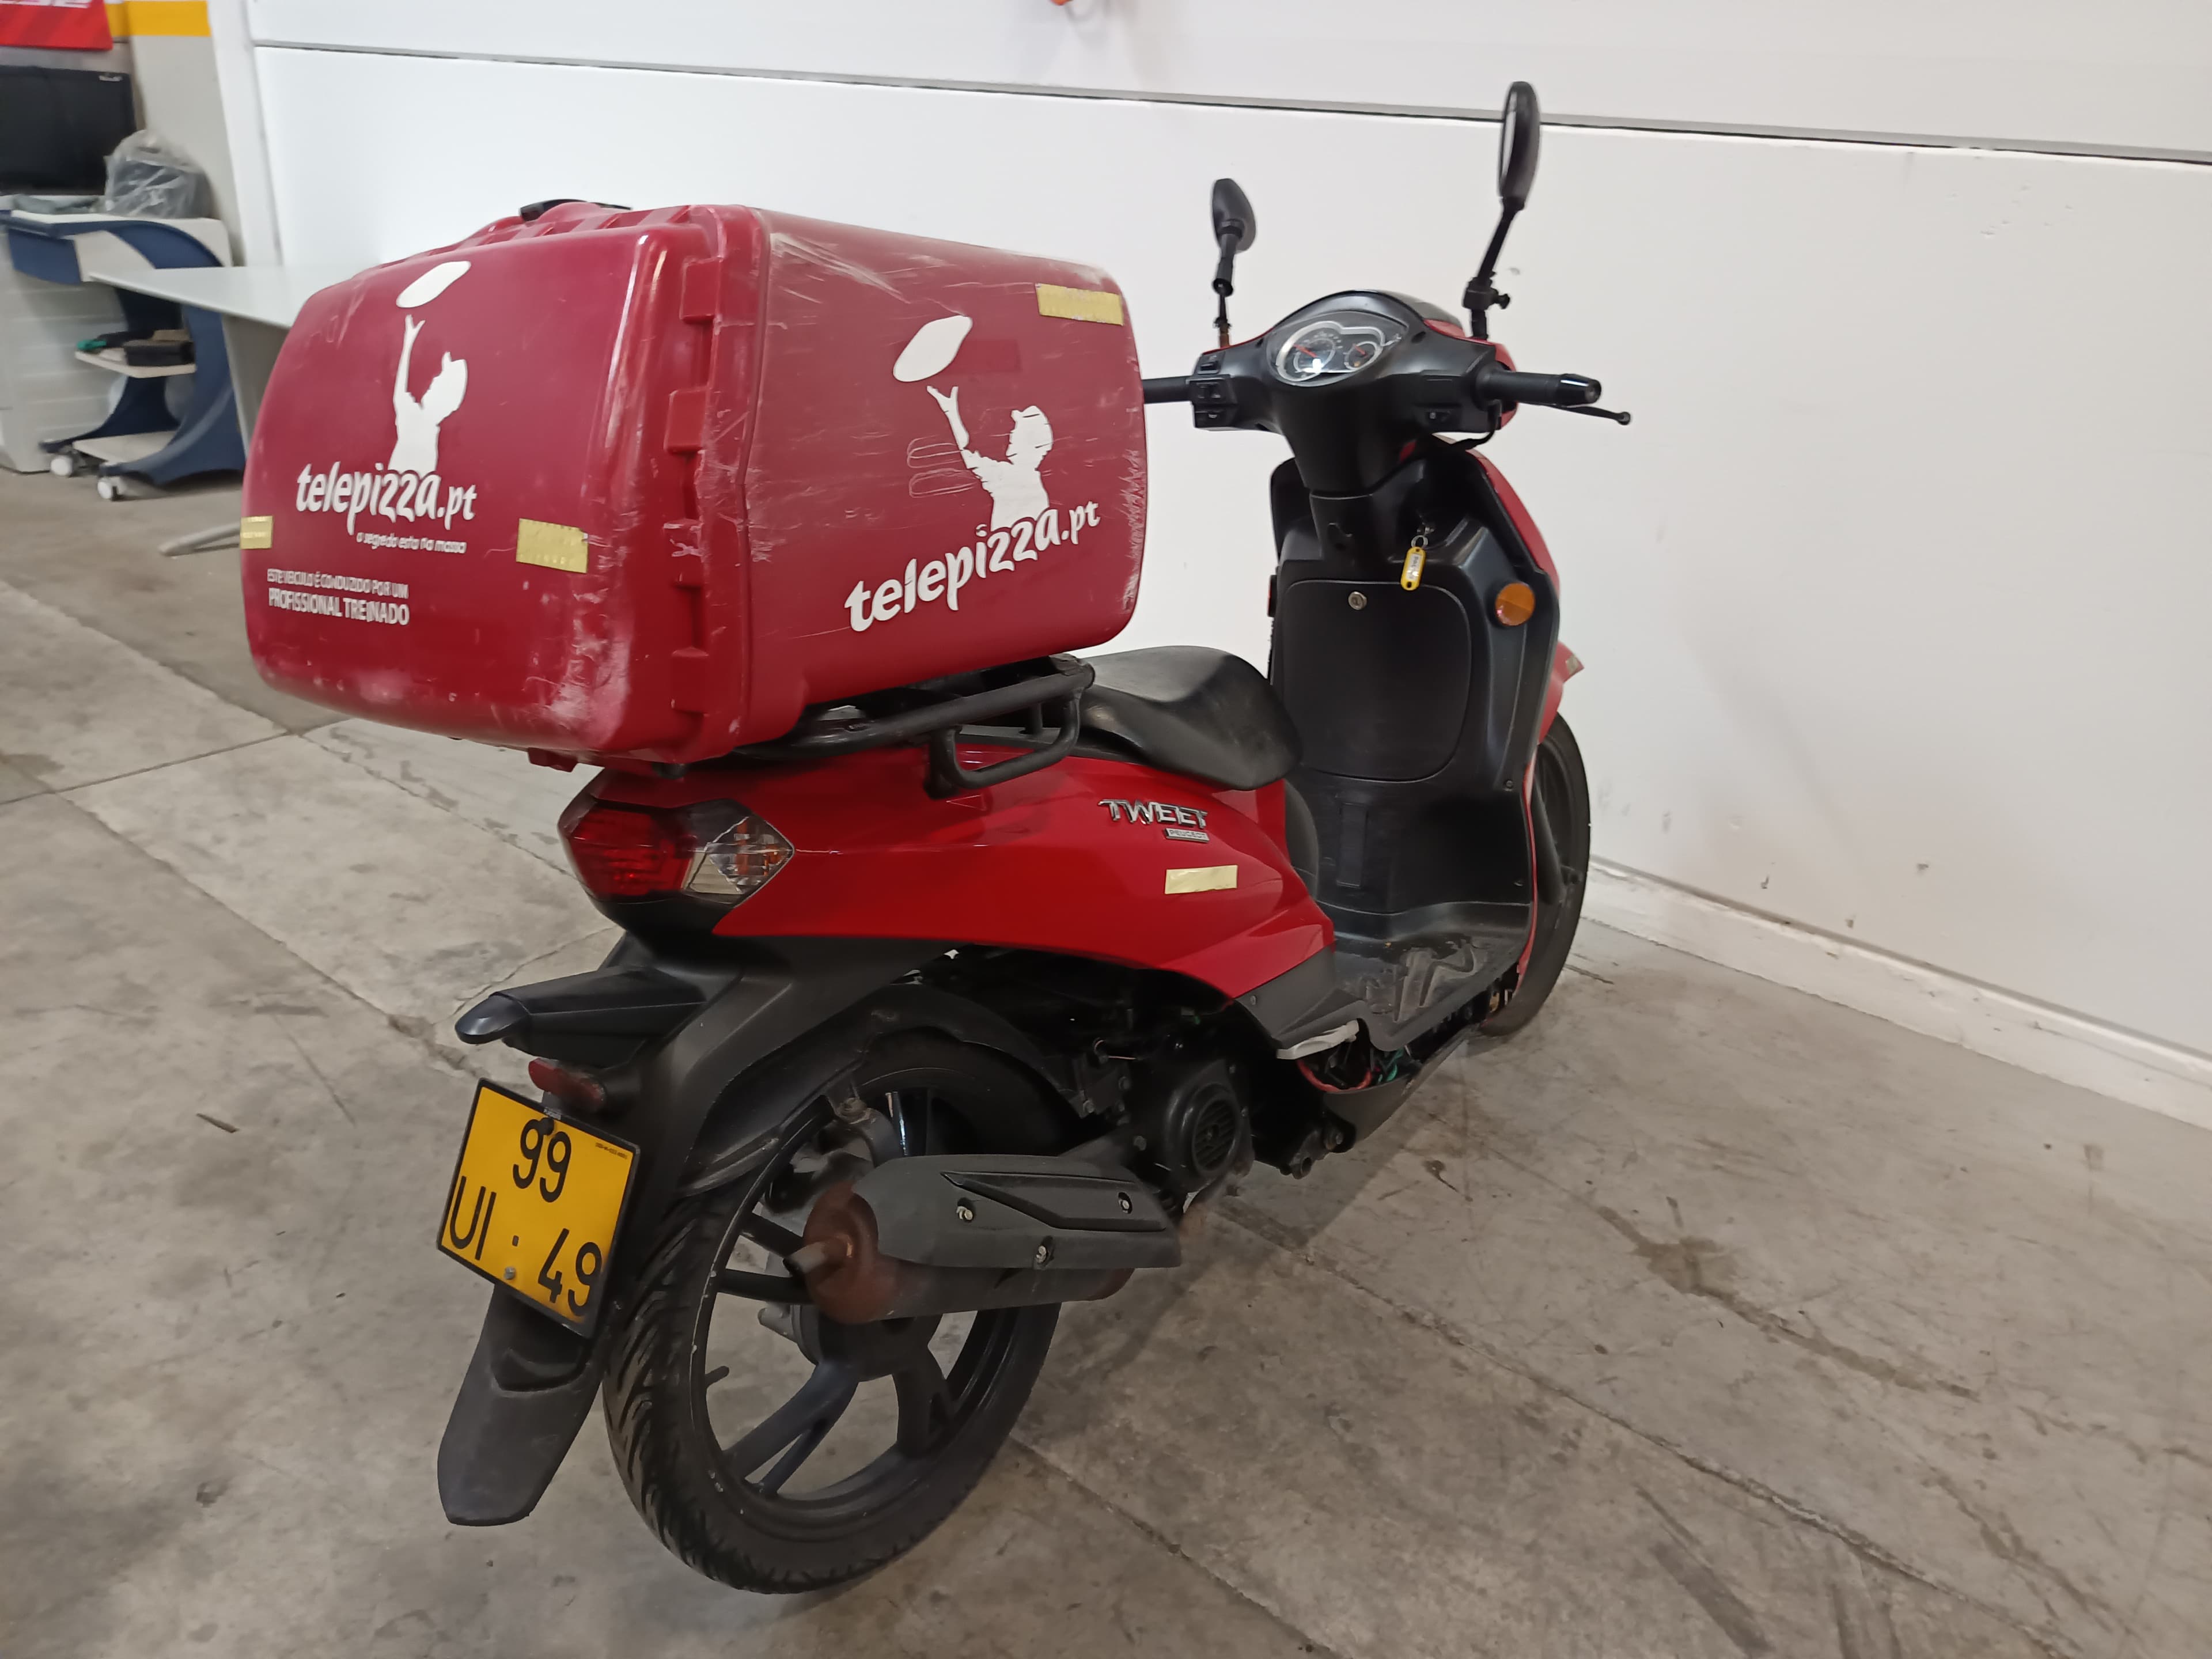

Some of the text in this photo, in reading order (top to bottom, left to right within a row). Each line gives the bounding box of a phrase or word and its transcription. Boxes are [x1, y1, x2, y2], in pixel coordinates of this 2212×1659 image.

[296, 461, 477, 535] telepizza.pt
[372, 579, 392, 596] POR
[844, 501, 1101, 632] telepizza.pt
[268, 587, 410, 625] PROFISSIONAL TREINADO
[1098, 798, 1207, 828] TWEET
[512, 1117, 572, 1203] 99
[449, 1175, 497, 1261] UI
[537, 1228, 603, 1317] 49
